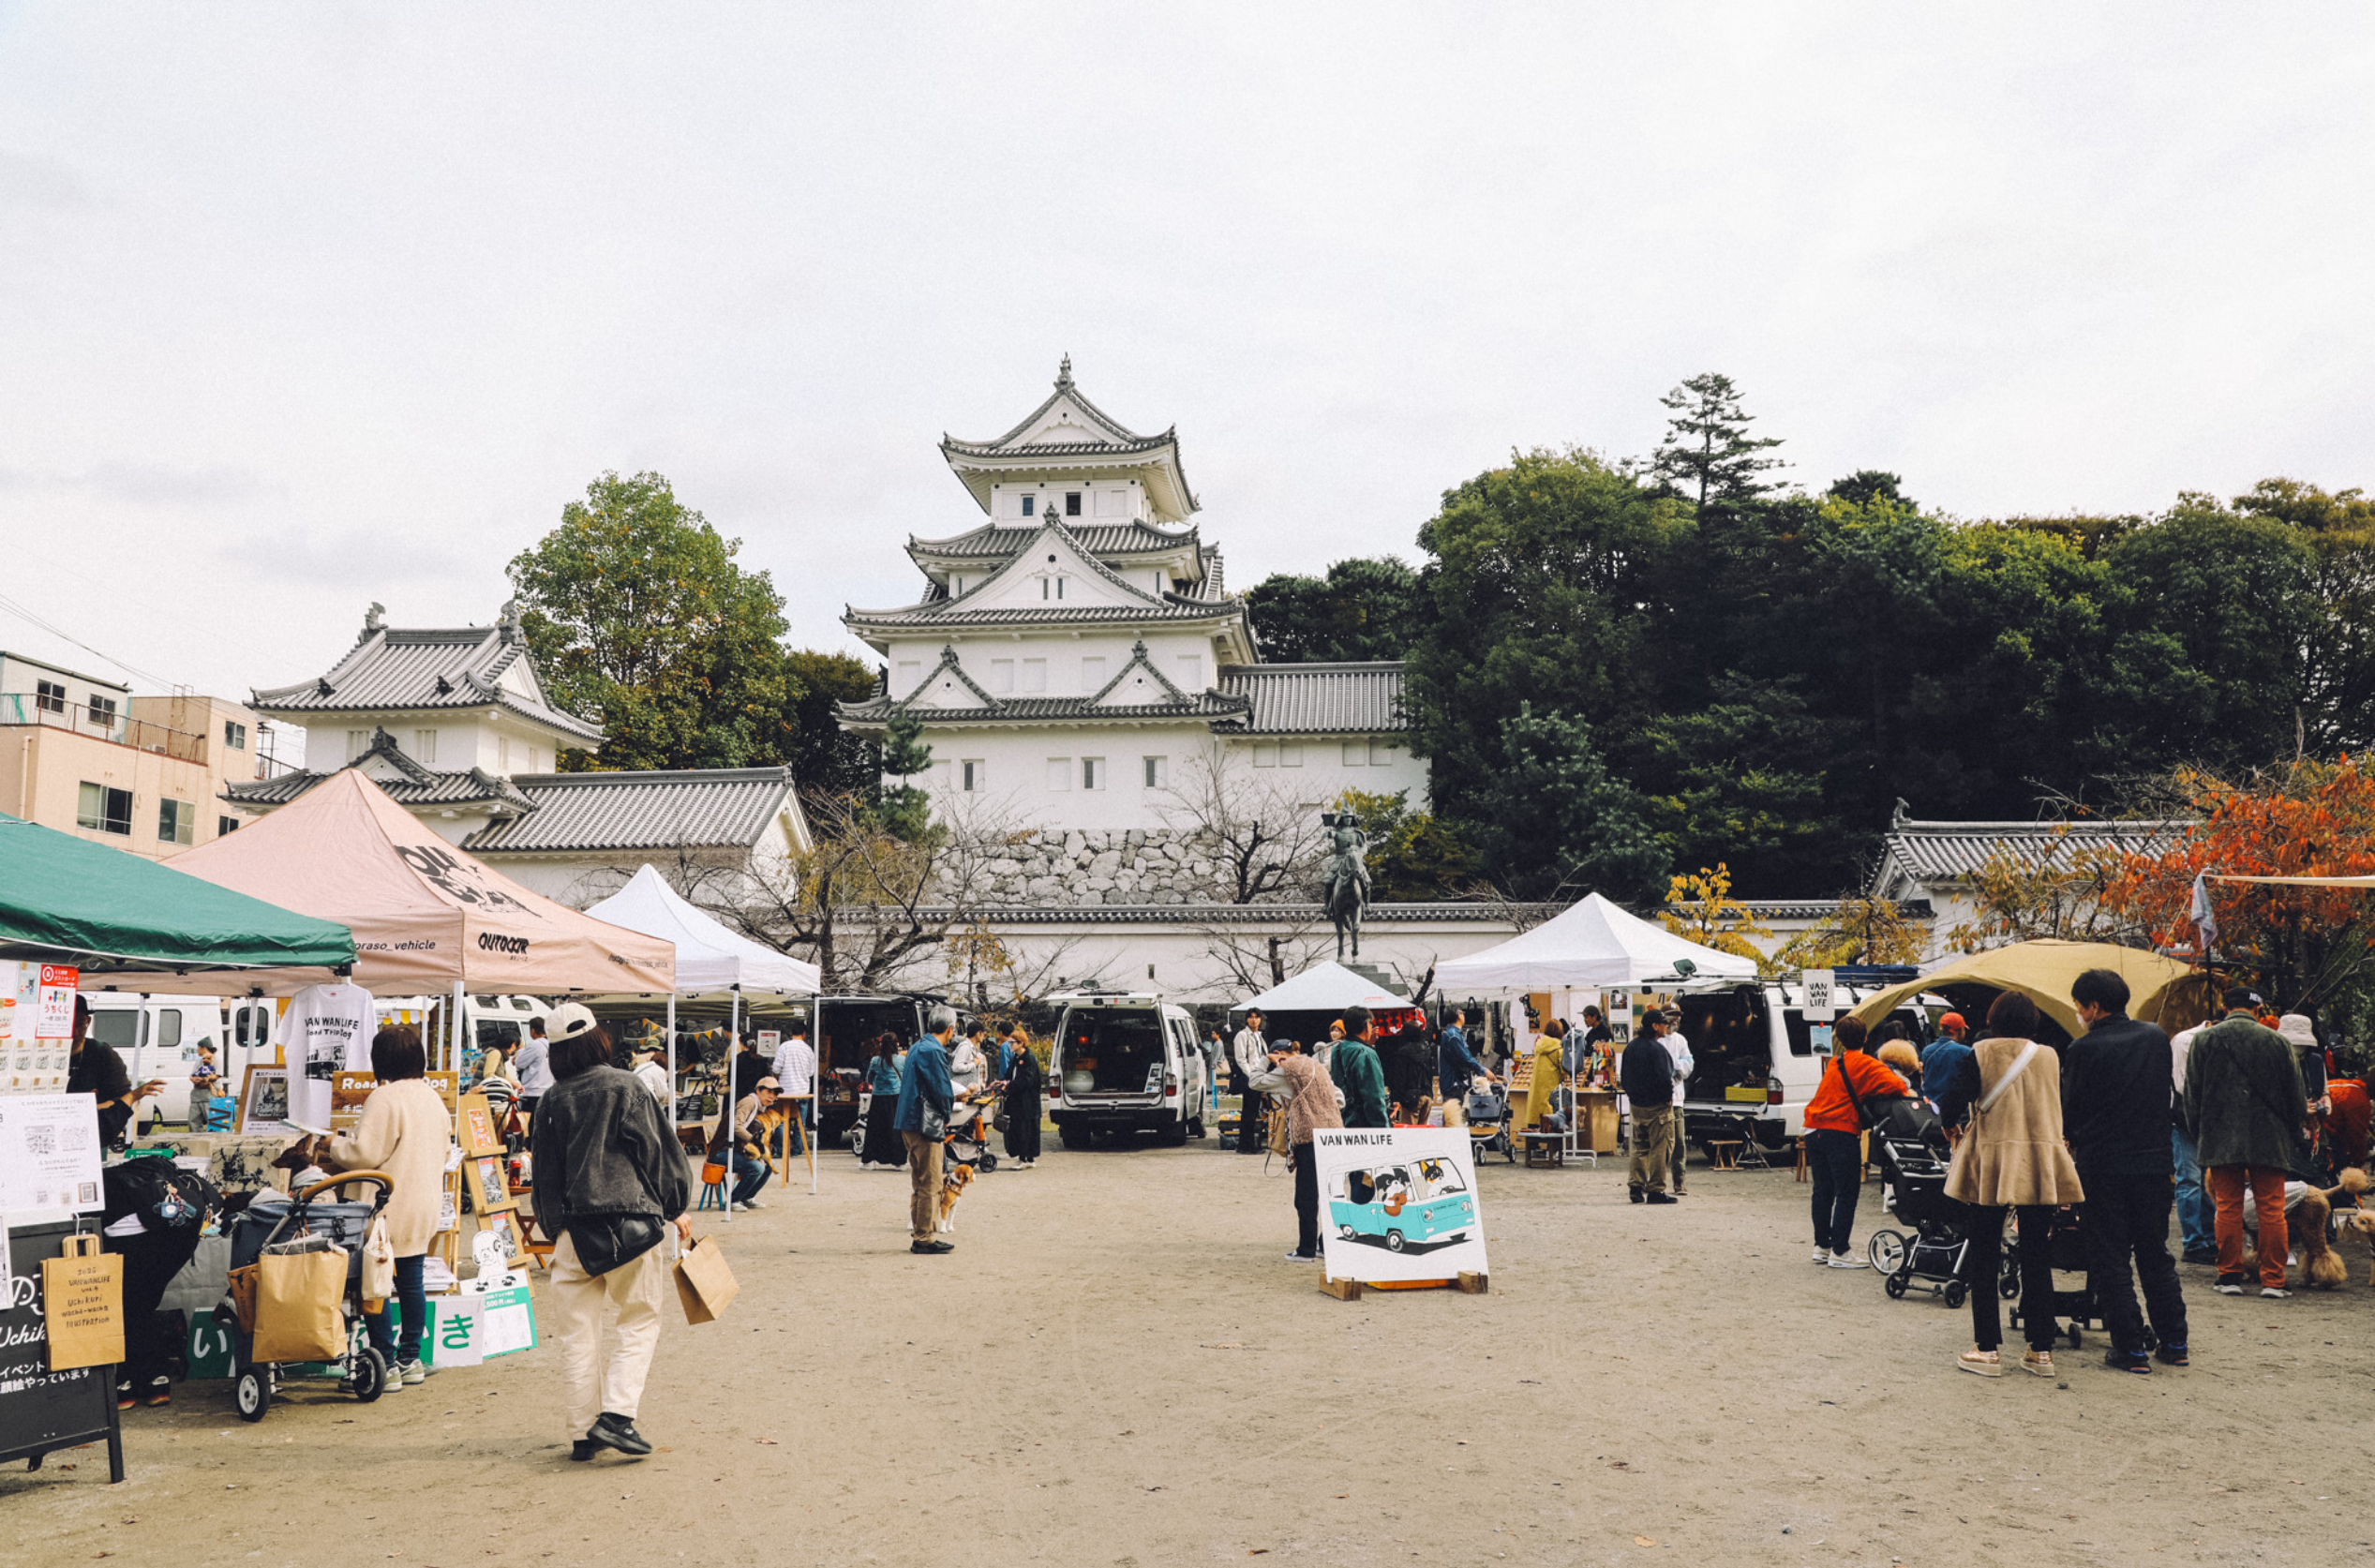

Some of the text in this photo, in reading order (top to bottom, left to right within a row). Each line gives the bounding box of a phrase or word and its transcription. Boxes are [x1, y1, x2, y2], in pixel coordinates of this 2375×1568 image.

[478, 933, 530, 954] OUTDOOR
[1810, 998, 1827, 1007] LIFE
[44, 1004, 70, 1014] うちくじ
[305, 1017, 359, 1030] VAN WAN LIFE
[342, 1077, 379, 1090] Road
[1320, 1134, 1394, 1146] VAN WAN LIFE
[78, 1267, 97, 1276] 2025
[0, 1367, 91, 1394] 顔絵やっています
